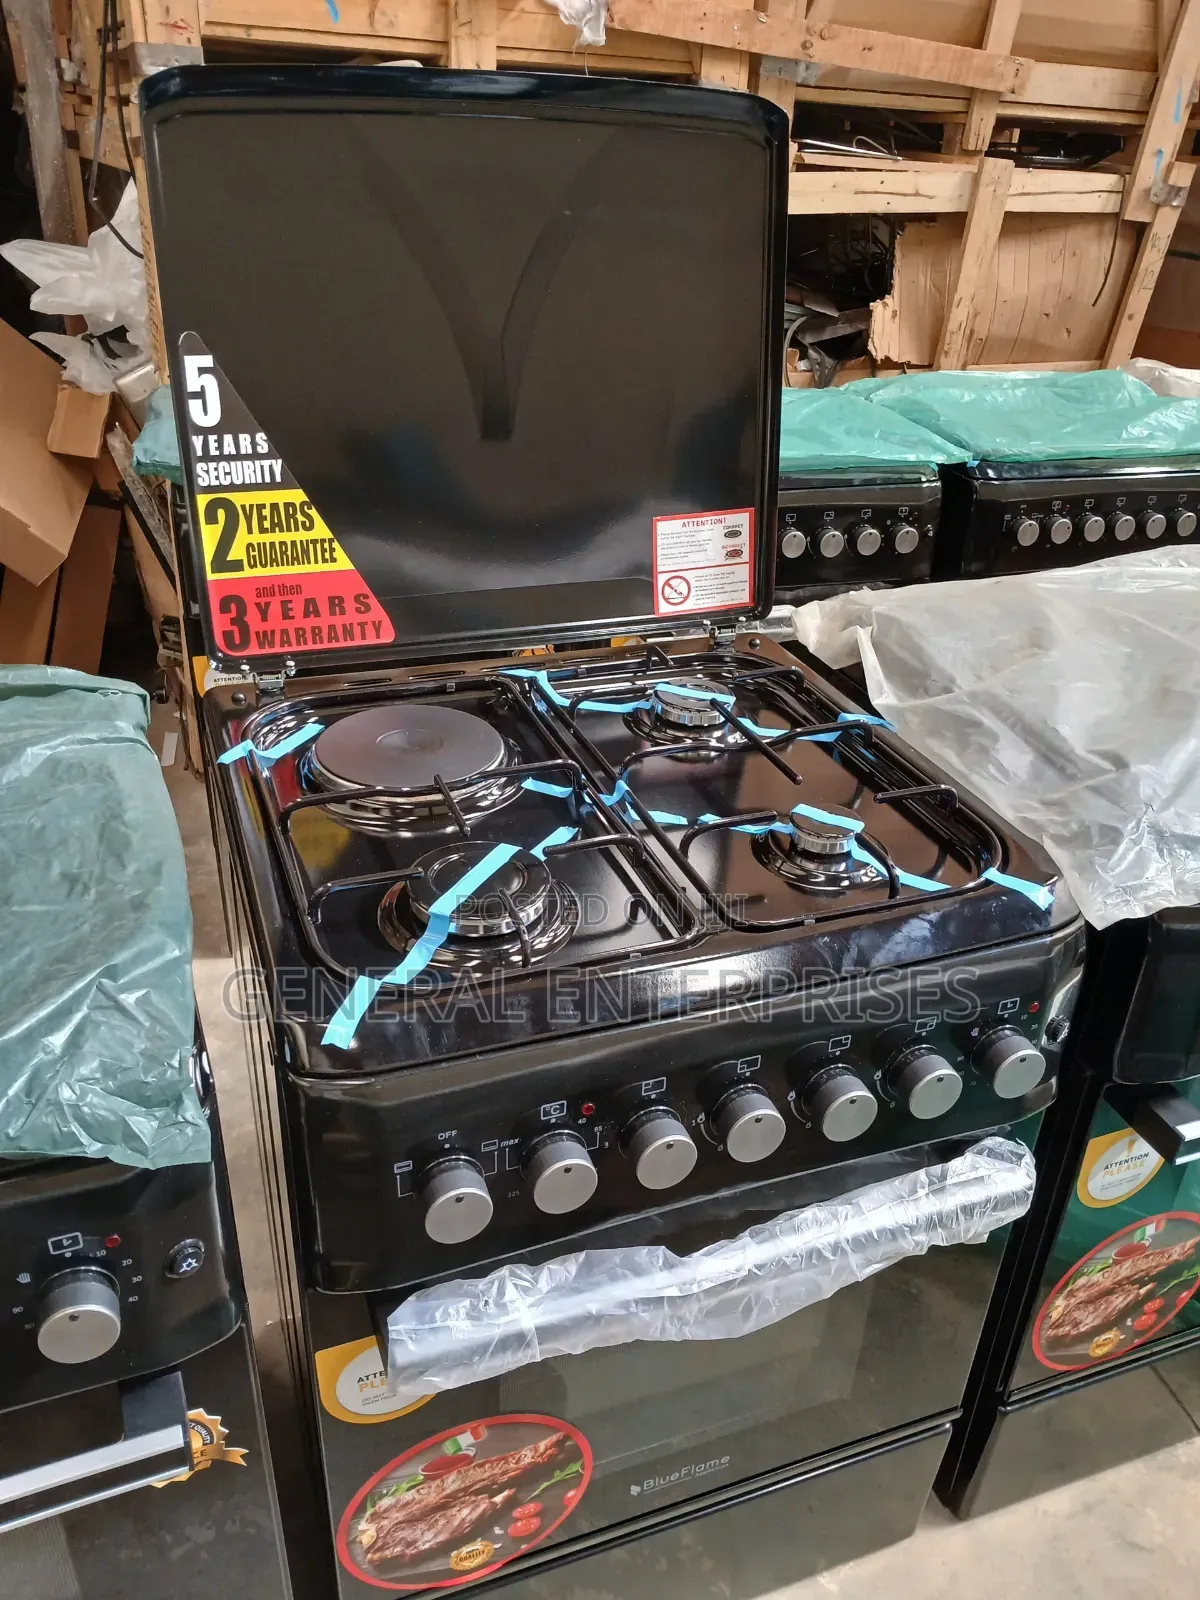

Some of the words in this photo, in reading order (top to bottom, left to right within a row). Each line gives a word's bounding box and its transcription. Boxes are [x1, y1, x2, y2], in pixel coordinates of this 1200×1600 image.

[183, 354, 222, 428] 5
[191, 432, 270, 457] YEARS
[196, 458, 283, 487] SECURITY
[240, 500, 316, 535] YEARS
[682, 517, 726, 528] ATTENTION!
[204, 497, 245, 574] 2
[245, 538, 337, 570] GUARANTEE
[255, 585, 277, 598] and
[277, 583, 303, 597] then
[254, 593, 373, 623] YEARS
[219, 594, 251, 653] 3
[255, 620, 383, 650] WARRANTY
[437, 1129, 458, 1141] OFF
[500, 1138, 520, 1148] max
[1103, 1160, 1145, 1178] PLEASE
[1104, 1152, 1150, 1170] ATTENTION
[507, 1190, 520, 1198] 225
[122, 1258, 133, 1266] 20
[12, 1306, 24, 1315] 90
[643, 1455, 730, 1490] BlueFlame
